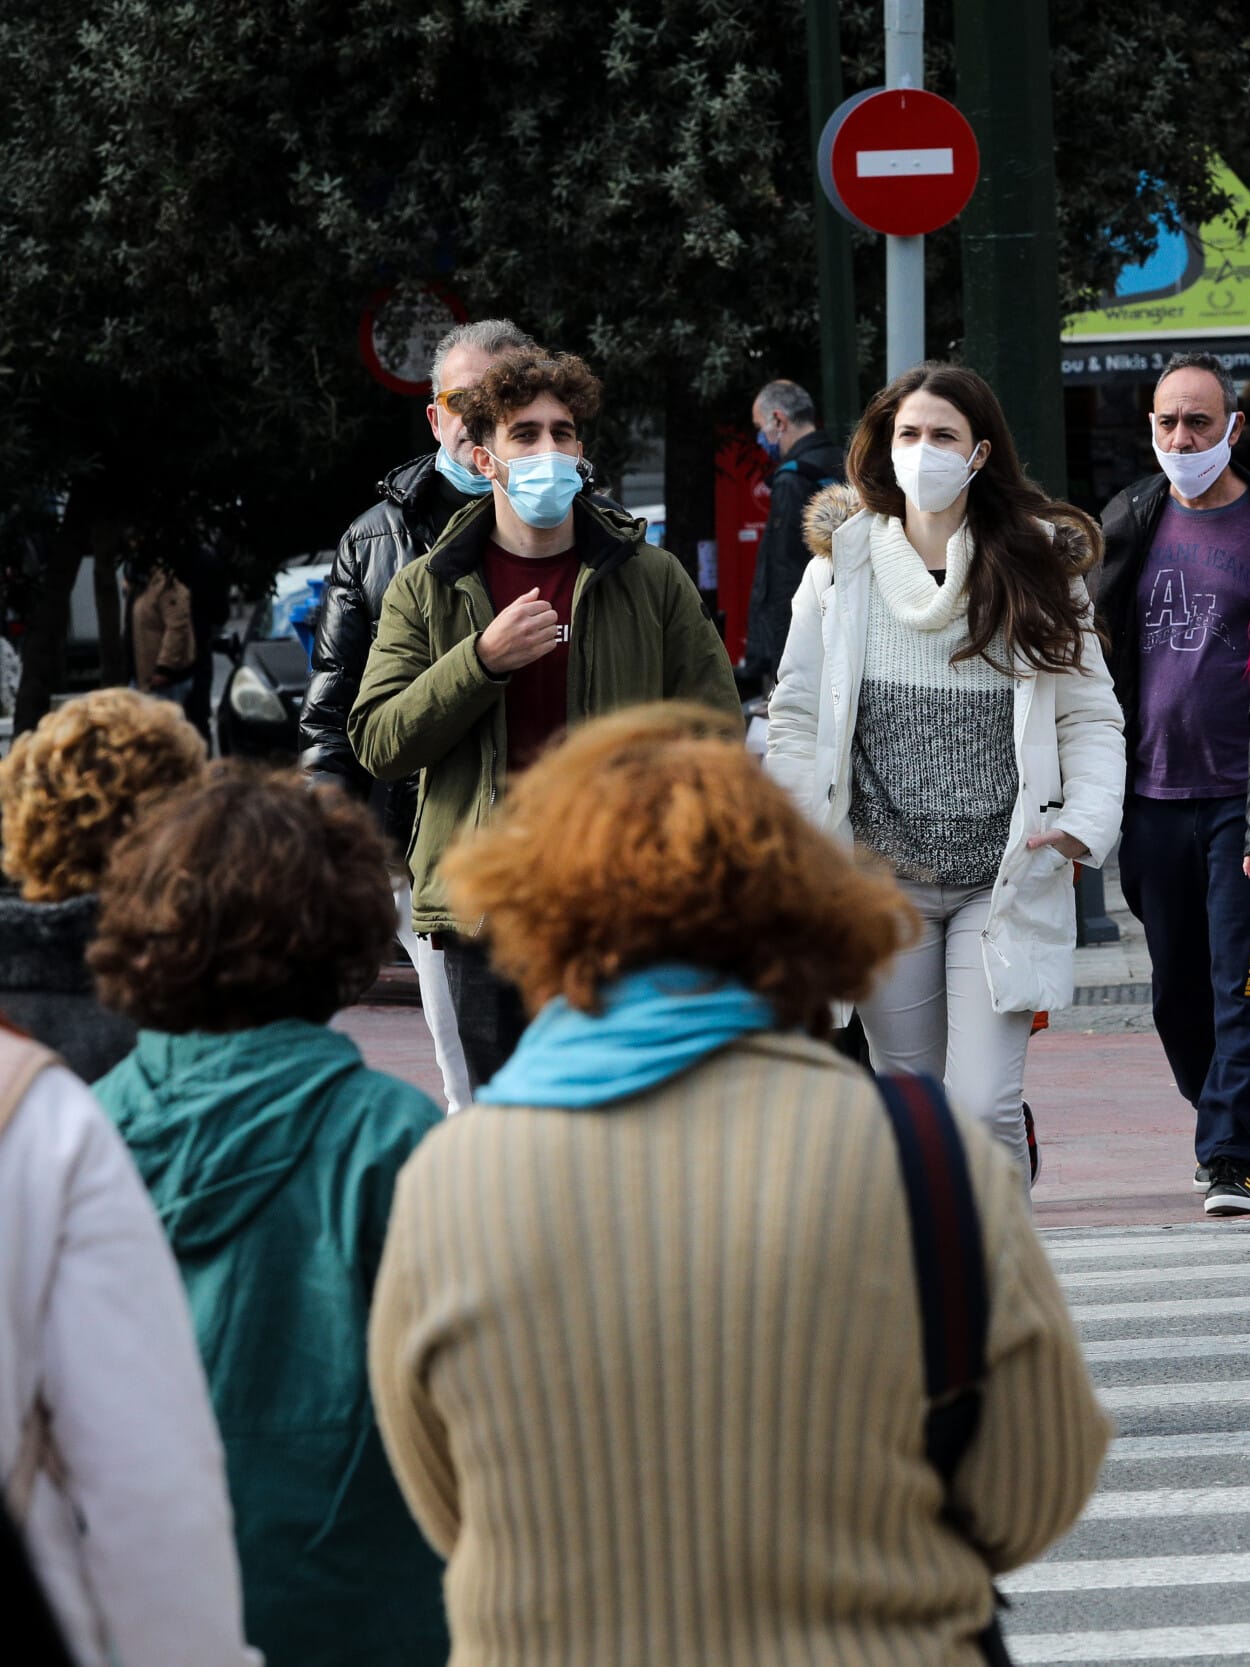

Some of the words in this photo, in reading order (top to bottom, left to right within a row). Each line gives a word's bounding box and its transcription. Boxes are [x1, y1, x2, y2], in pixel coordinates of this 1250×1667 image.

[1105, 305, 1185, 325] Wrangler
[1061, 359, 1086, 374] ou
[1088, 355, 1102, 373] &
[1105, 353, 1148, 371] Nikis
[554, 624, 569, 643] EI
